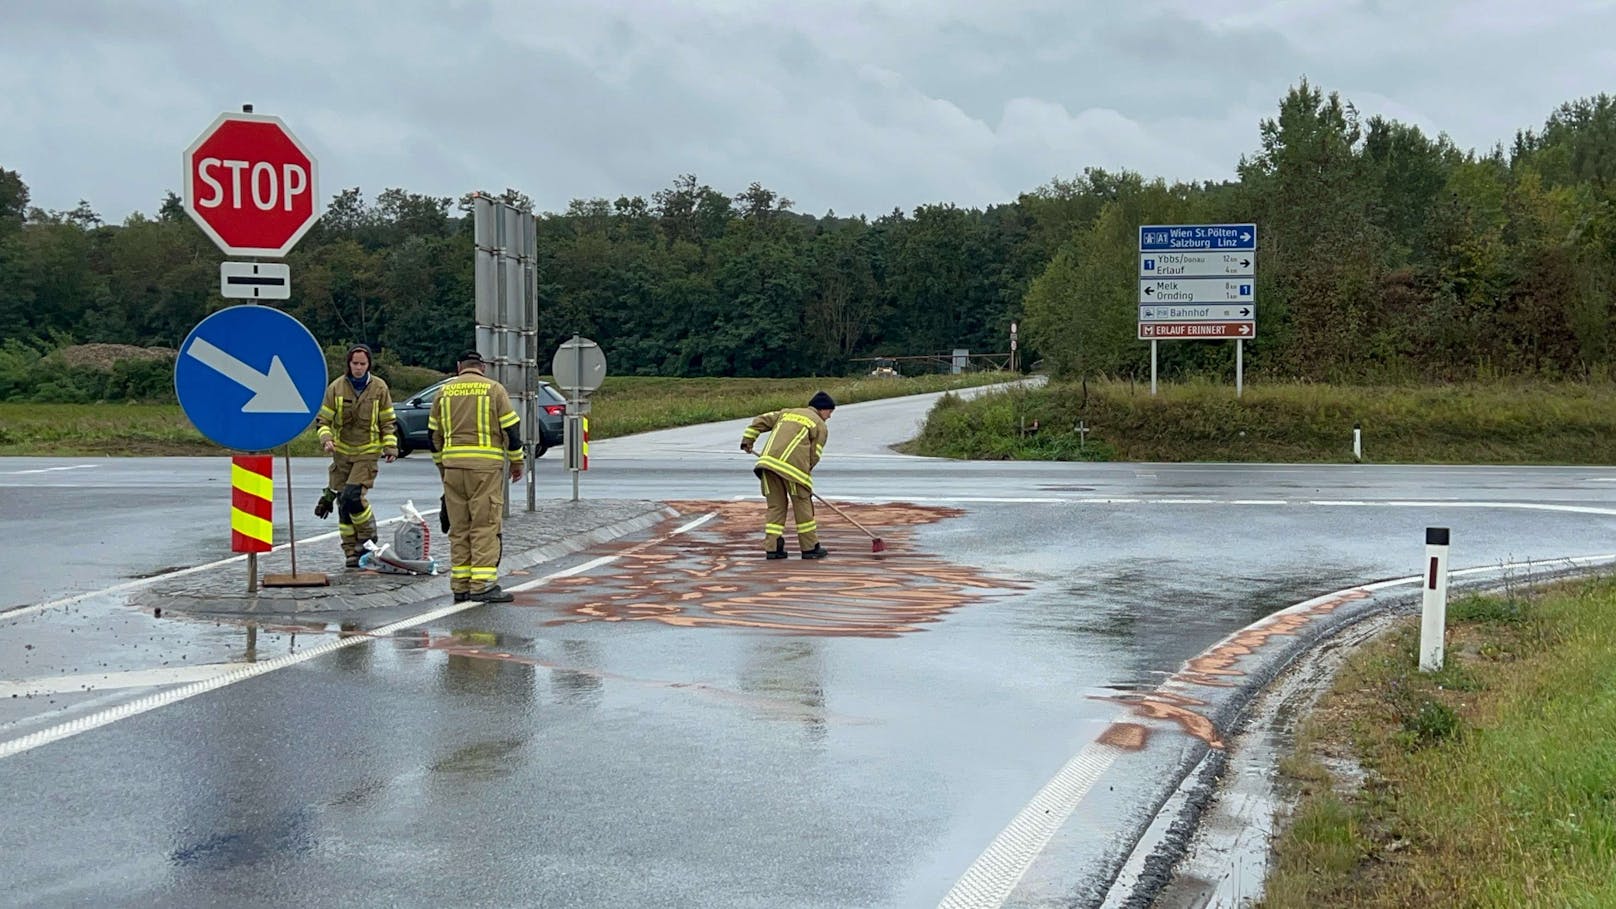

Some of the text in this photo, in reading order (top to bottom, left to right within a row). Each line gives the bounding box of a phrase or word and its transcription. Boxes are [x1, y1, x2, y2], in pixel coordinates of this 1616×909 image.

[198, 157, 307, 212] STOP
[1157, 233, 1168, 244] A1
[1170, 229, 1193, 238] Wien
[1170, 238, 1238, 249] Salzburg Linz
[1157, 266, 1185, 275] Erlauf
[1157, 281, 1178, 290] Melk
[1157, 291, 1194, 301] Ornding
[1170, 308, 1209, 317] Bahnhof
[1156, 325, 1186, 335] ERLAUF
[1187, 325, 1226, 335] ERINNERT
